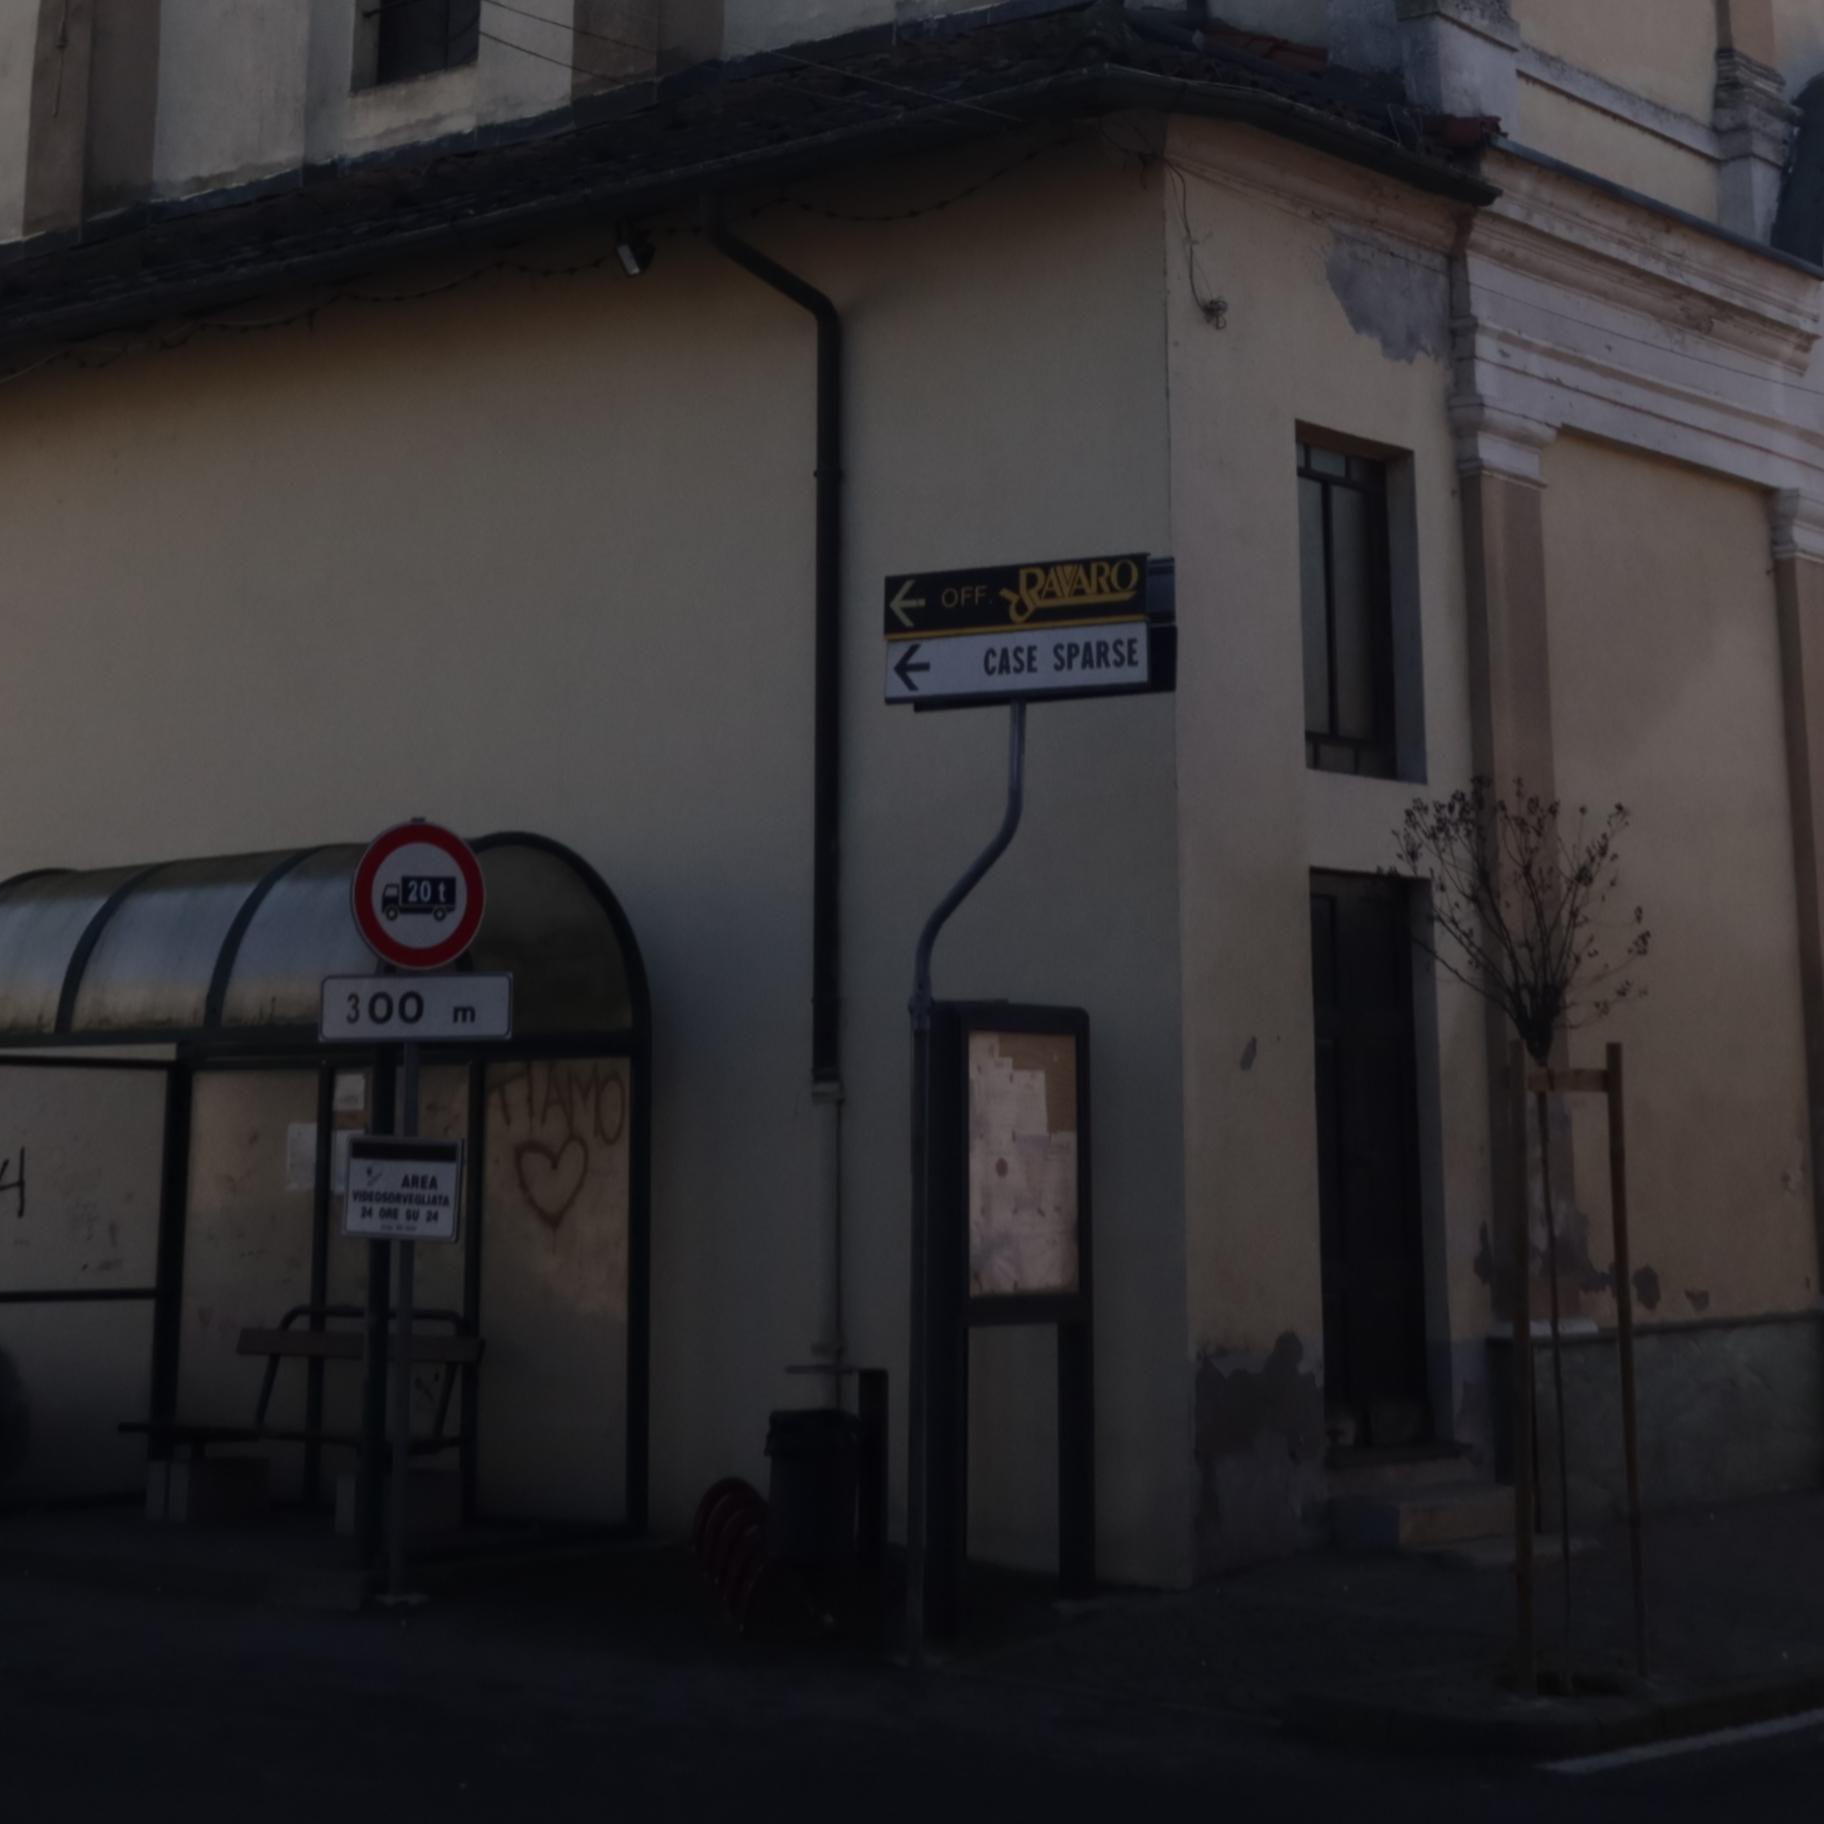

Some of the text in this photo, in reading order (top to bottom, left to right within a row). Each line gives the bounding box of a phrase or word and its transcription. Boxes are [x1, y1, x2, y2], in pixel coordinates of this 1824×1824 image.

[983, 637, 1139, 677] CASE SPARSE
[408, 879, 447, 903] 20 t
[346, 990, 476, 1024] 300 m
[401, 1174, 438, 1190] AREA
